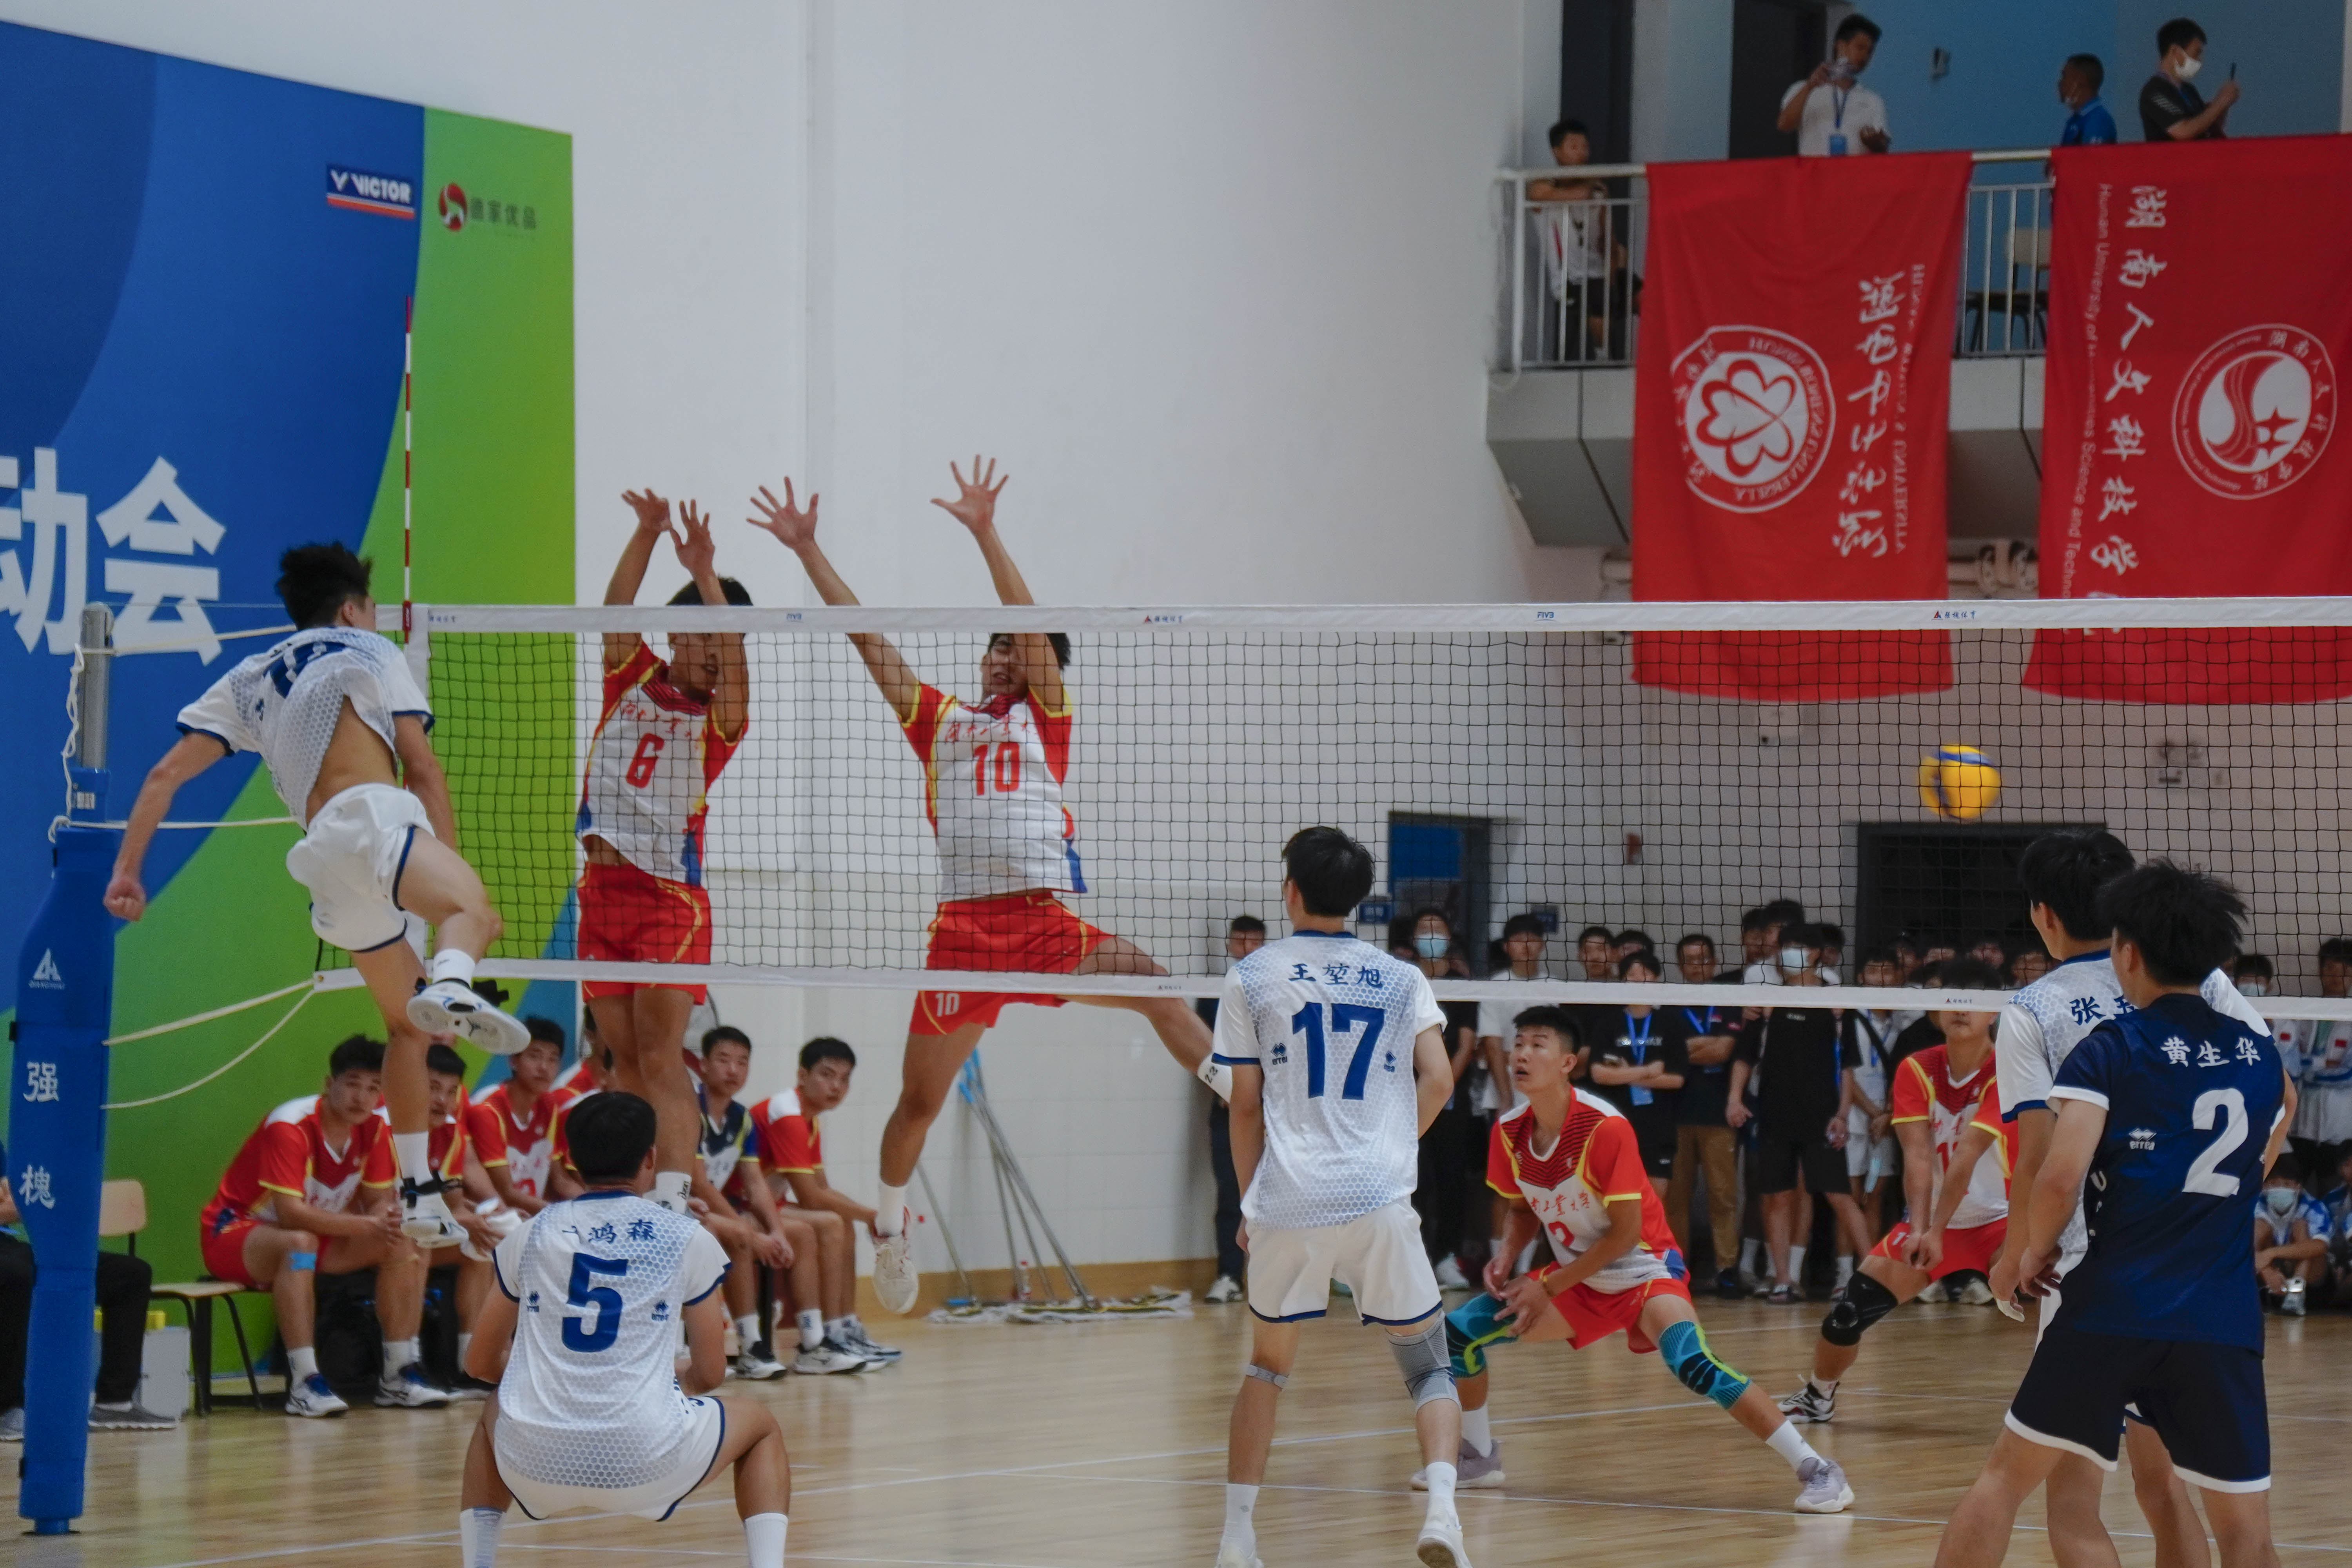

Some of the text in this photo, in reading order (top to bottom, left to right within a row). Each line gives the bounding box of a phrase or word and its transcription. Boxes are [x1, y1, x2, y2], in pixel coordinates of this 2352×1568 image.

[350, 172, 411, 205] VICTOR
[2098, 183, 2112, 239] Hunan
[2084, 243, 2111, 319] University
[2088, 185, 2167, 598] 湖南人文科技学
[2073, 441, 2096, 505] Science
[2068, 509, 2083, 537] and
[0, 446, 226, 666] 动会
[2062, 541, 2082, 599] Techno
[626, 733, 665, 789] 6
[973, 742, 1020, 795] 10
[1288, 963, 1385, 989] 王堃旭
[935, 993, 960, 1018] 10
[1291, 1001, 1387, 1100] 17
[2160, 1035, 2261, 1068] 黄生华
[2130, 1141, 2156, 1151] errea
[2182, 1087, 2249, 1198] 2
[562, 1252, 628, 1352] 5
